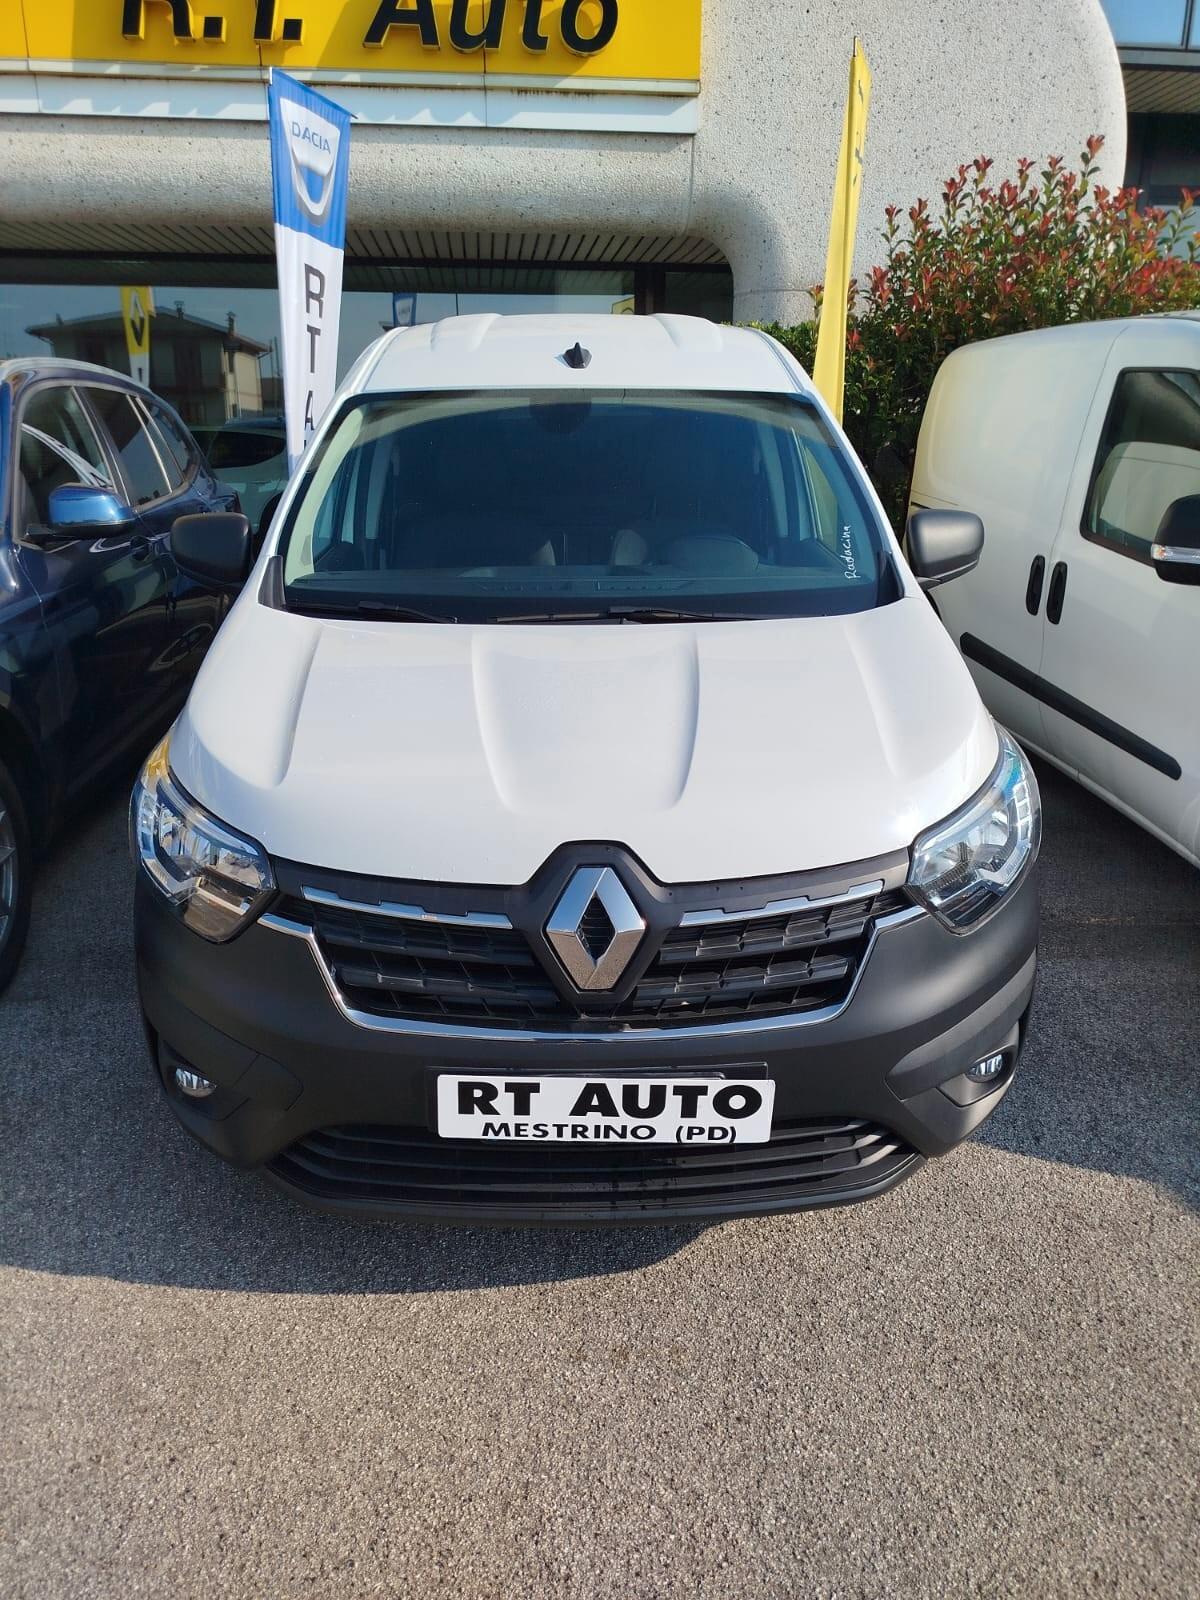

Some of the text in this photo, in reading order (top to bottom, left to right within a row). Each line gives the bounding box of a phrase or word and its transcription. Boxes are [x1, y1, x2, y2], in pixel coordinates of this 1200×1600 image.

[363, 0, 619, 54] Auto
[291, 121, 331, 155] DACIA
[457, 1081, 763, 1120] RT AUTO
[481, 1122, 737, 1143] MESTRINO (PD)
